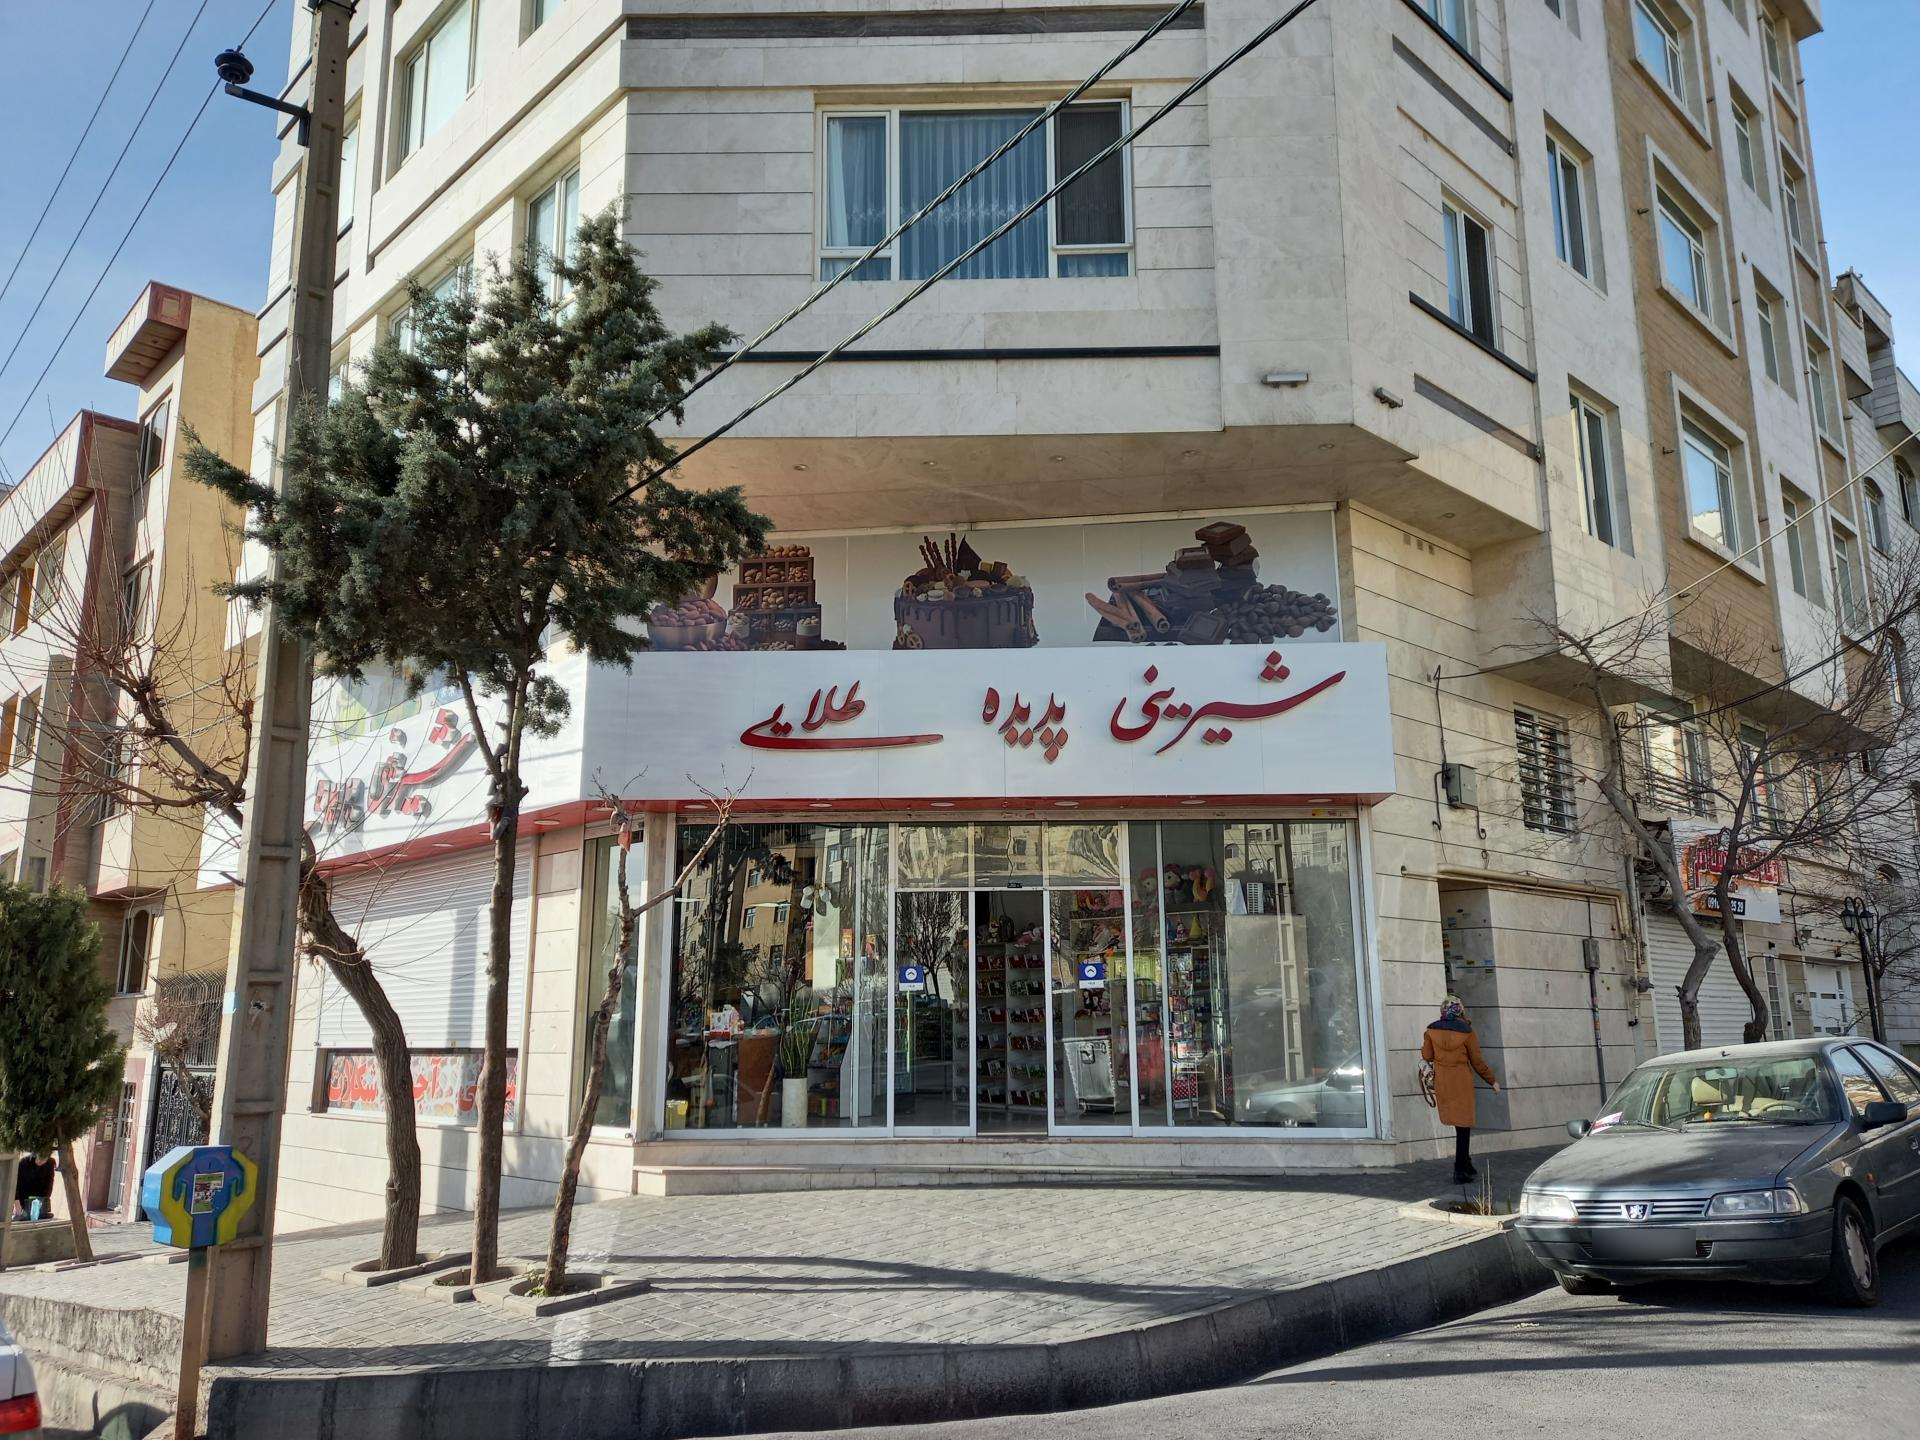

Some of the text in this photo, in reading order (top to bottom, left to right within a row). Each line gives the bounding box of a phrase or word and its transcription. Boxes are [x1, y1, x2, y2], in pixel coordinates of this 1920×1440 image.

[740, 650, 1346, 763] شیرینی پدیده طلایی
[328, 1056, 379, 1106] شکلات
